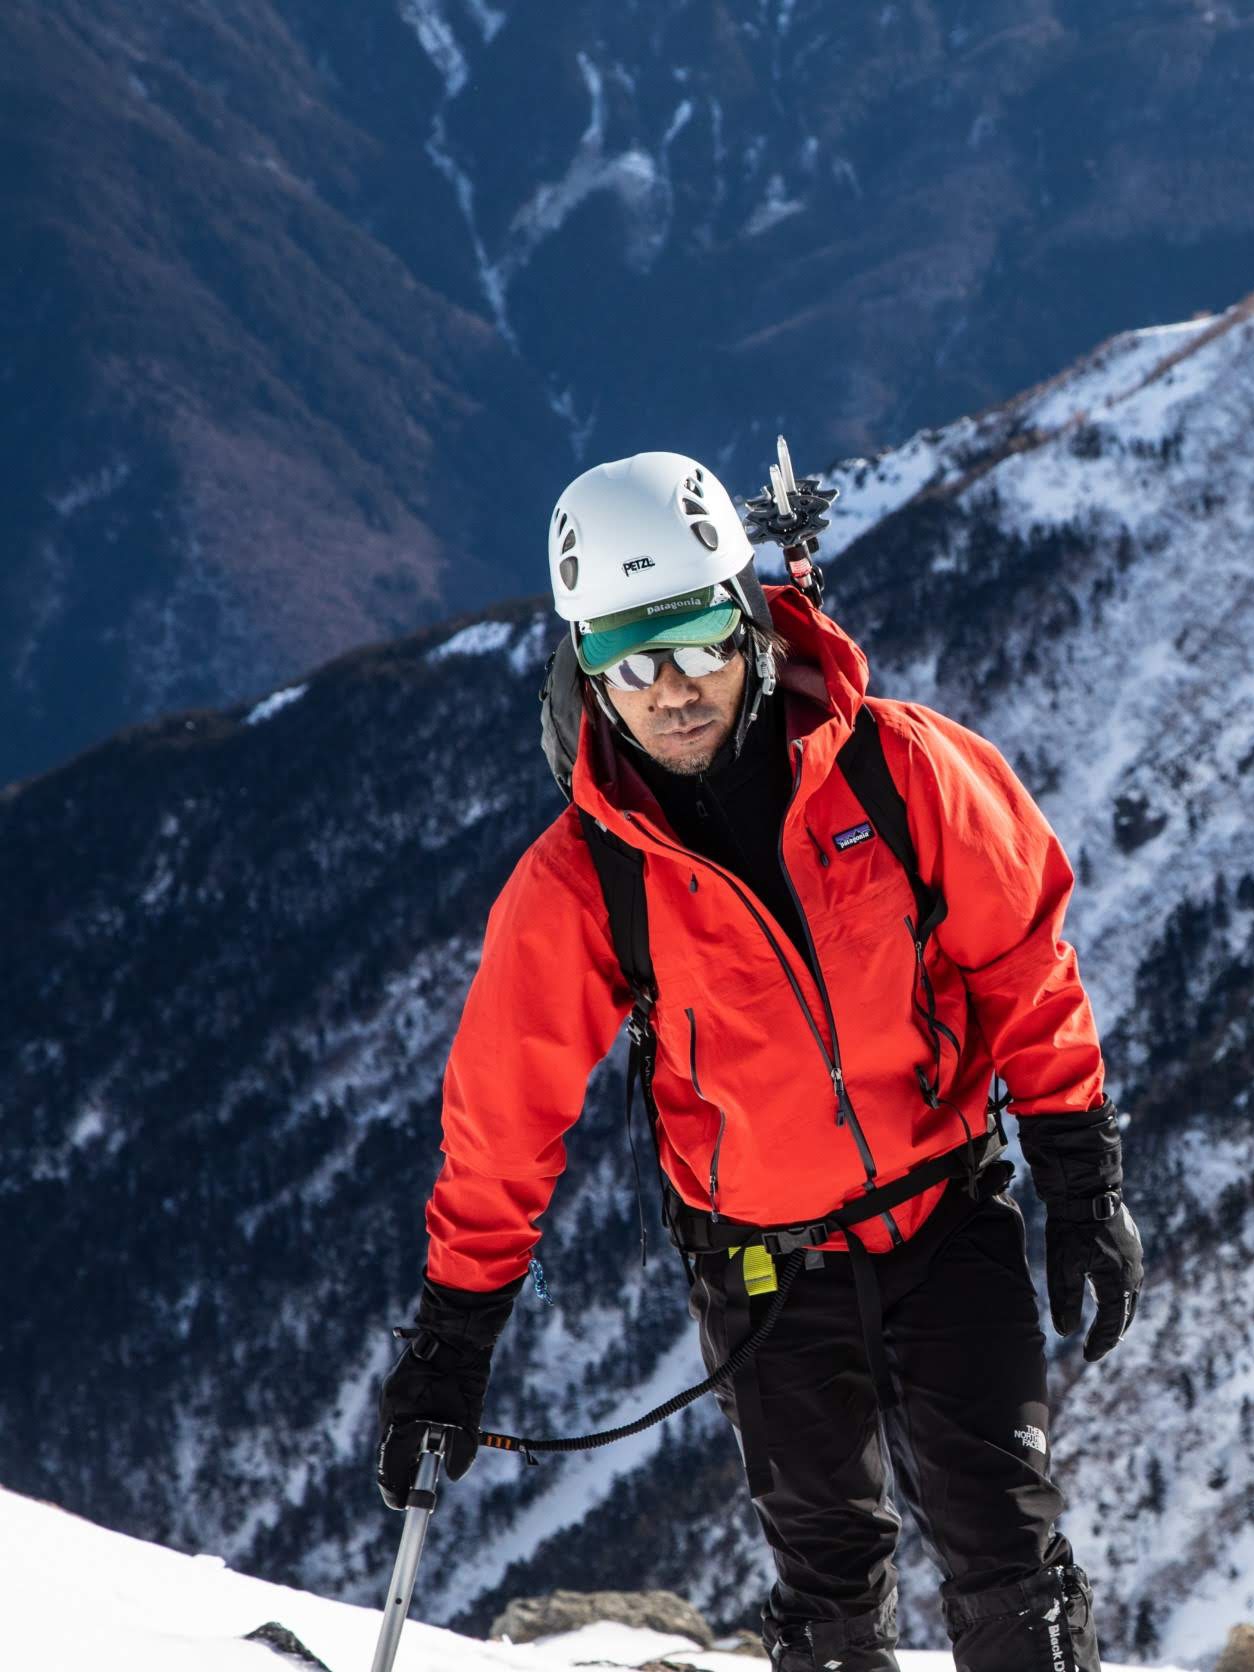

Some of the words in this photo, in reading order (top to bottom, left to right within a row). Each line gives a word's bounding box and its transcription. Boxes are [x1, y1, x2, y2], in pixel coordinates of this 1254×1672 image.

[622, 557, 656, 577] PETZL
[646, 597, 702, 616] patagonia
[840, 831, 869, 849] patagonia
[1014, 1429, 1040, 1442] NORTH
[1026, 1424, 1041, 1436] THE
[1022, 1438, 1041, 1450] FACE
[1048, 1623, 1064, 1661] Black
[1053, 1660, 1066, 1672] D
